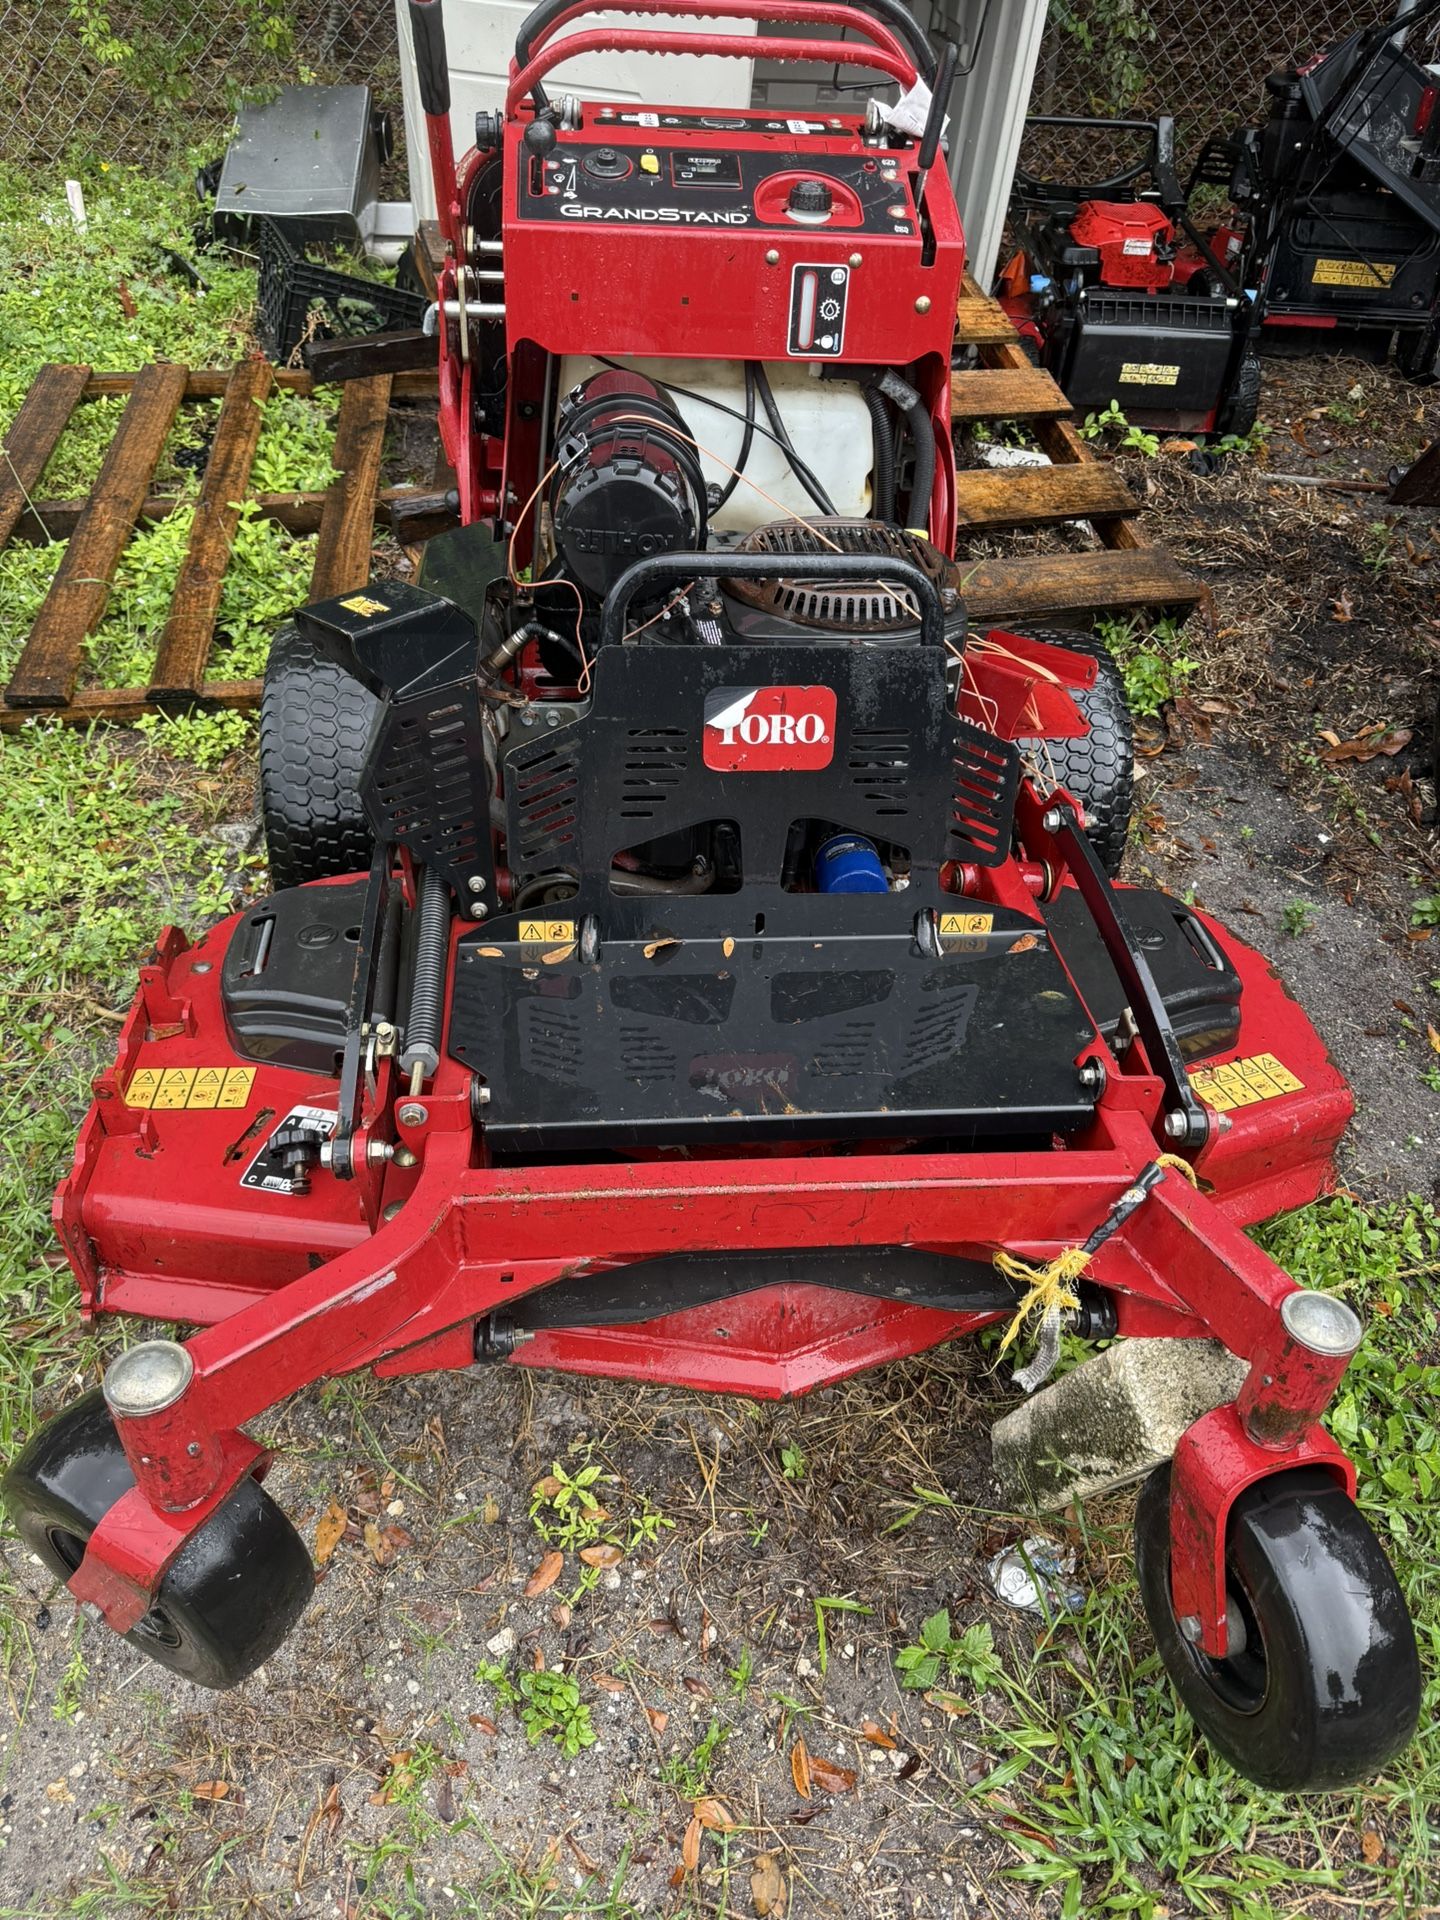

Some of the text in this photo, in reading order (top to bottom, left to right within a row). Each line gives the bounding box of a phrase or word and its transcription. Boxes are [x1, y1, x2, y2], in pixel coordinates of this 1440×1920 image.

[574, 528, 674, 556] KOHLER
[287, 1118, 296, 1126] A
[248, 1175, 258, 1183] C
